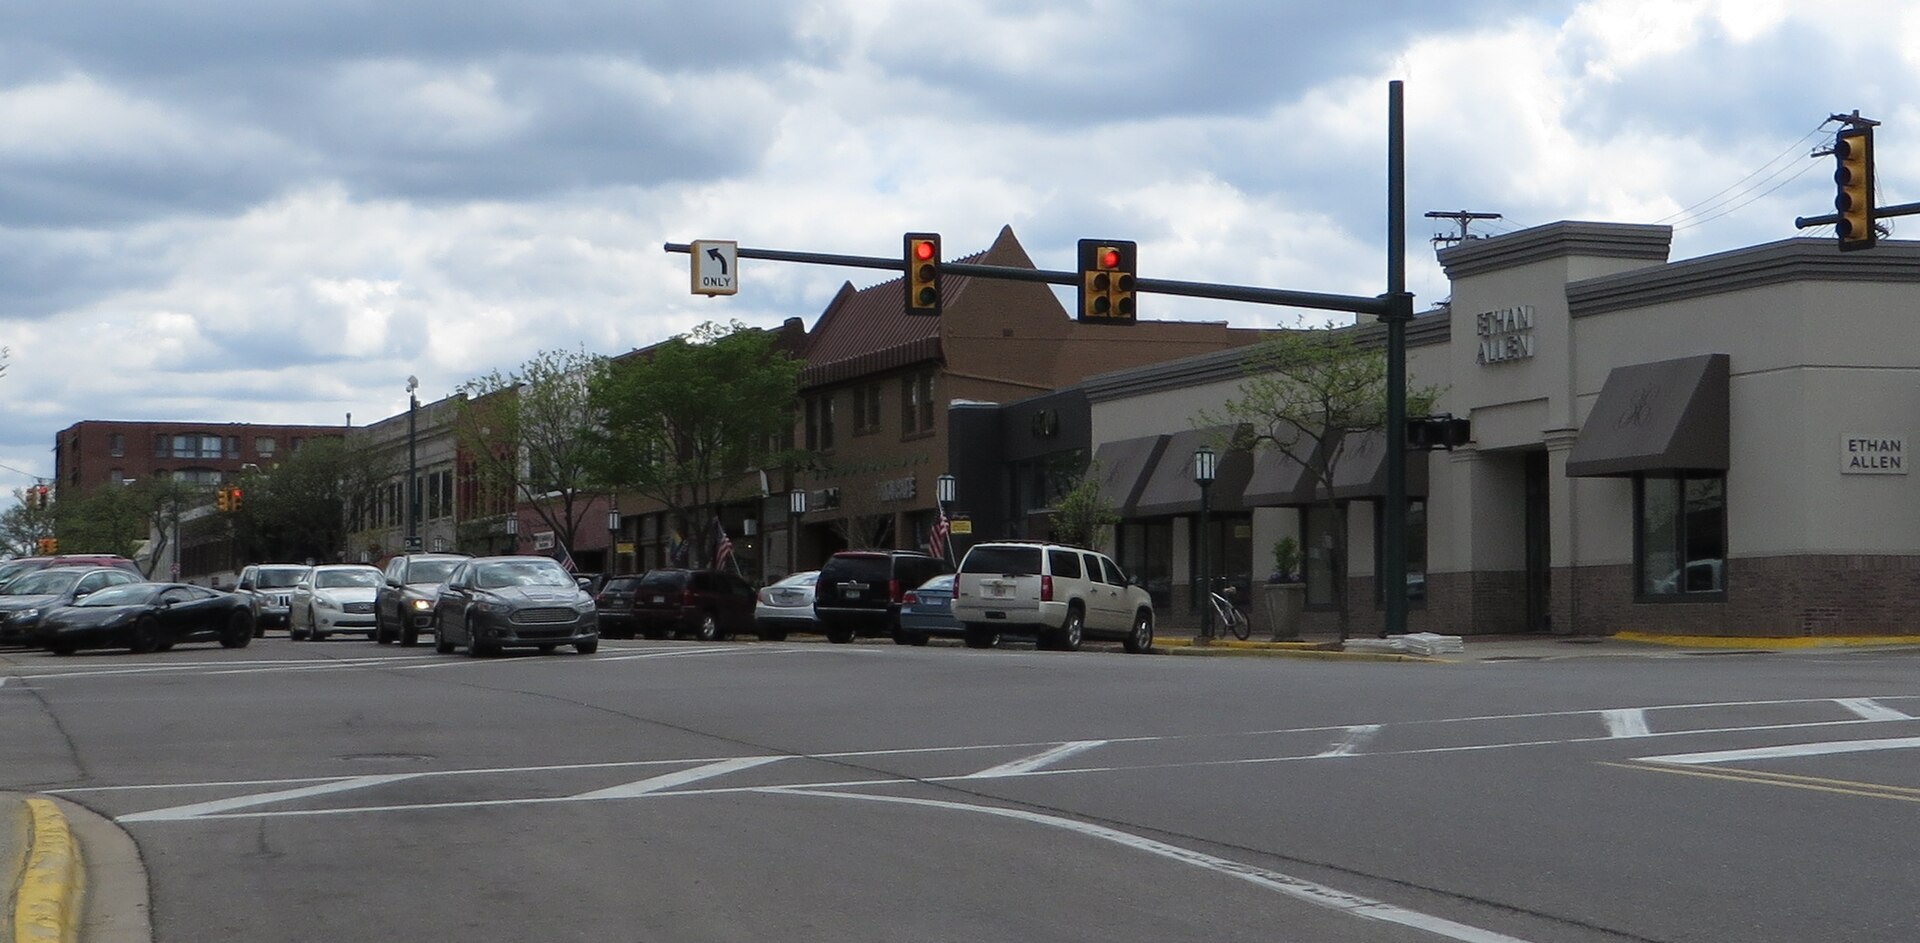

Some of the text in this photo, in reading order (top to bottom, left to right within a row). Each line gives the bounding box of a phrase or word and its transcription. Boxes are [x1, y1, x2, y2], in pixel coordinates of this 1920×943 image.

[703, 277, 731, 287] ONLY
[1477, 305, 1535, 336] ETHAN
[1475, 335, 1535, 364] ALLEN
[1848, 439, 1901, 451] ETHAN
[1850, 456, 1901, 468] ALLEN
